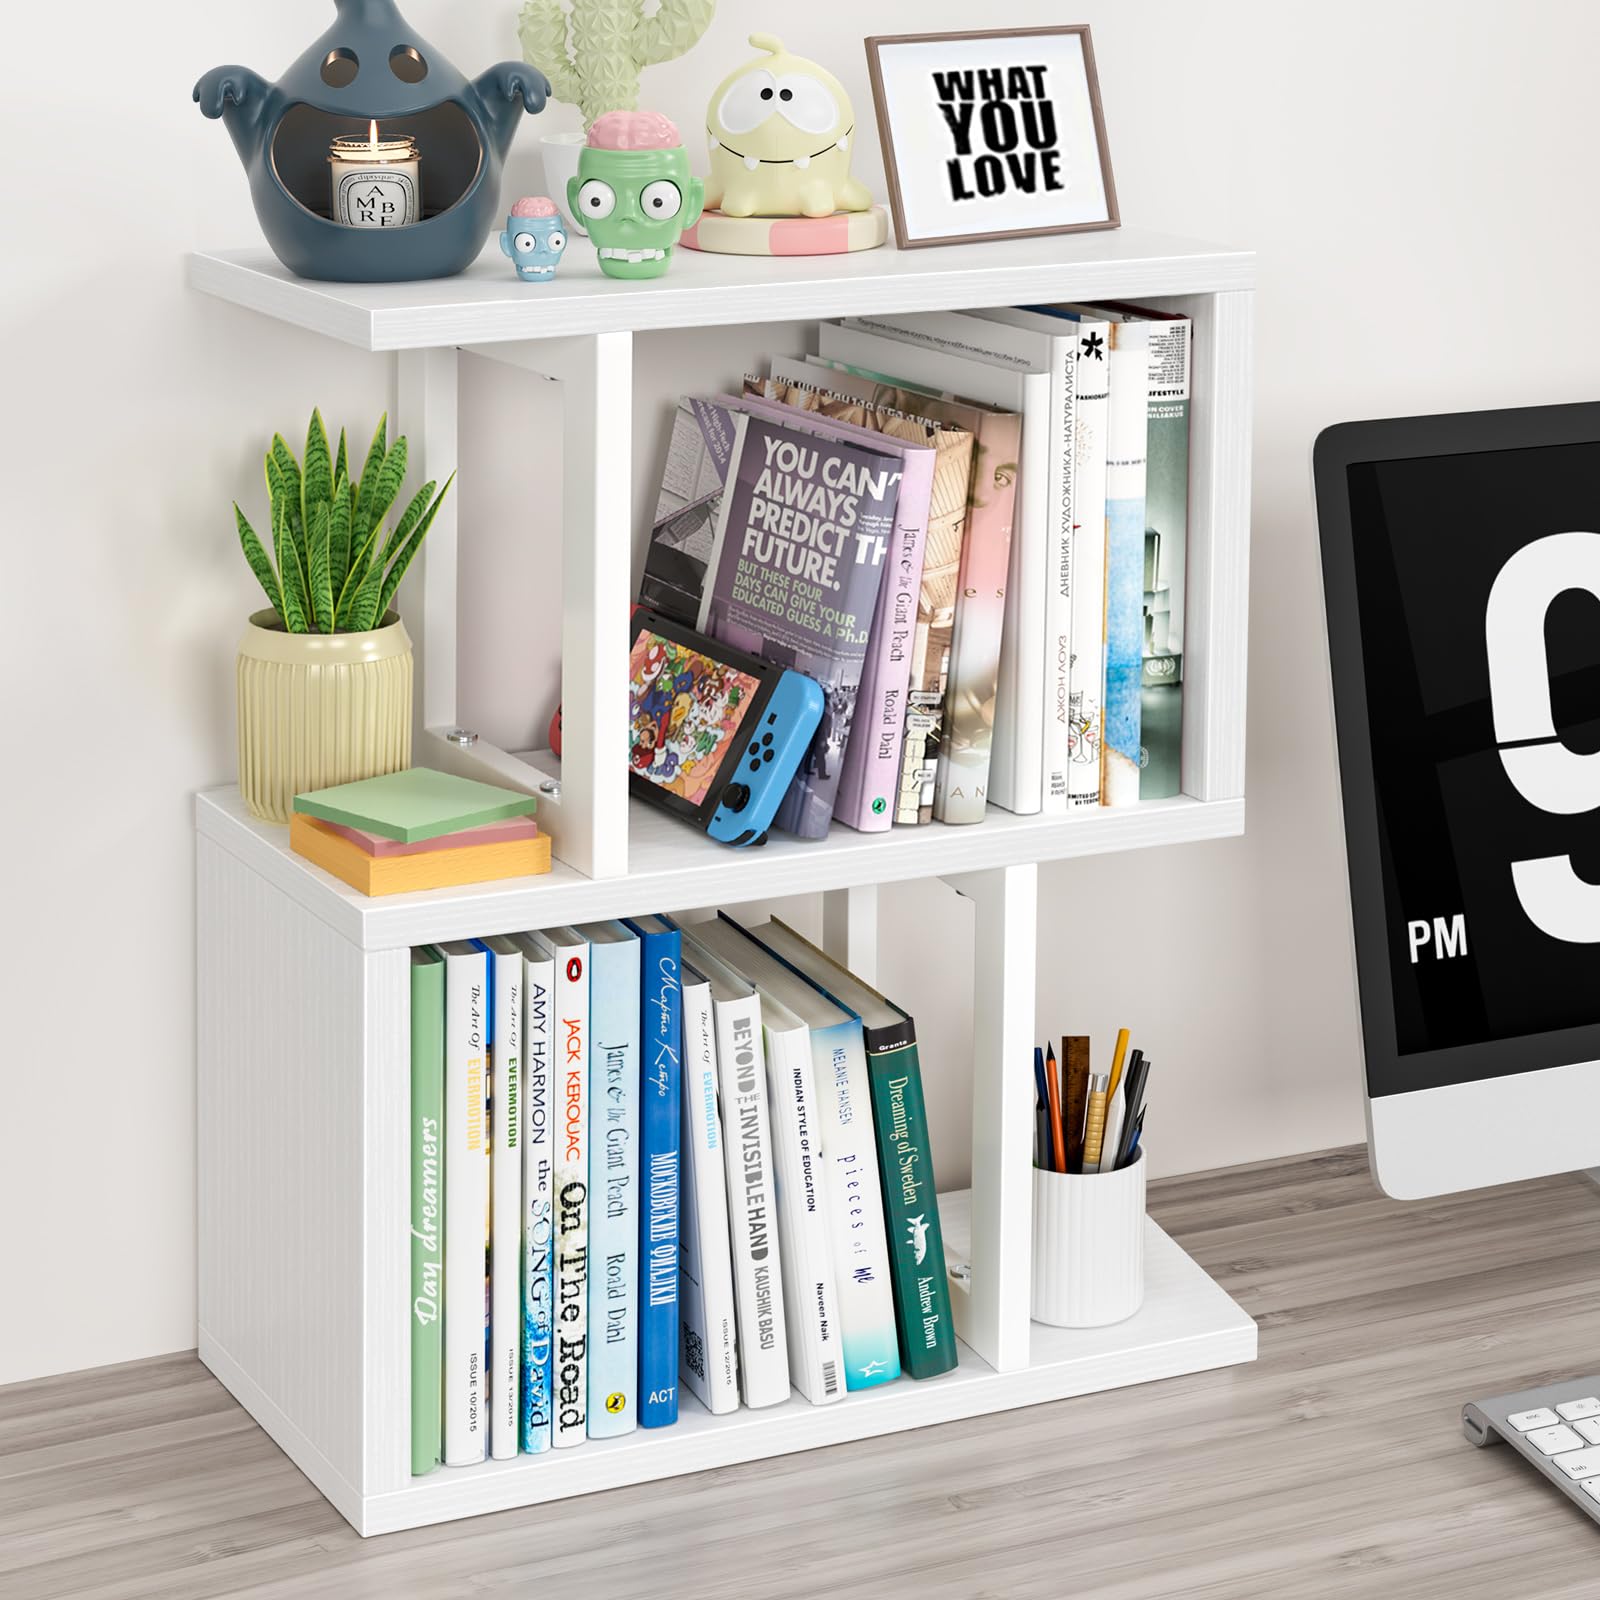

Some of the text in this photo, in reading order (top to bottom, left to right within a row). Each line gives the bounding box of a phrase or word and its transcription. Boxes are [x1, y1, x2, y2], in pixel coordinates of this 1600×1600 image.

[932, 65, 1047, 101] WHAT
[937, 99, 1058, 155] YOU
[947, 150, 1064, 201] LOVE
[713, 441, 727, 464] 2014
[763, 435, 820, 479] YOU
[1060, 350, 1075, 597] ДНЕВНИК ХУДОЖНИКА-НАТУРАЛИСТА
[752, 469, 858, 527] ALWAYS
[747, 498, 851, 558] PREDICT
[898, 524, 921, 558] James
[736, 559, 823, 601] BUT THESE FOUR
[741, 526, 840, 592] FUTURE.
[731, 588, 785, 617] EDUCATED
[786, 607, 821, 632] GUESS
[823, 623, 832, 637] A
[735, 573, 857, 629] DAYS CAN GIVE YOUR
[895, 591, 913, 624] Giant
[890, 629, 910, 663] Peach
[1057, 635, 1067, 724] ДЖОН ЛОУЗ
[882, 689, 899, 726] Roald
[878, 732, 896, 760] Dahl
[1408, 913, 1468, 964] PM
[510, 984, 518, 1002] The
[700, 1010, 708, 1027] The
[597, 1041, 629, 1085] James
[832, 1048, 849, 1088] MELANIE
[878, 1039, 908, 1051] Granta
[508, 1057, 517, 1148] EVERMOTION
[703, 1071, 718, 1150] EVERMOTION
[836, 1088, 854, 1126] HANSEN
[606, 1127, 630, 1171] Giant
[888, 1076, 923, 1206] Dreaming of Sweden
[467, 984, 481, 1433] The Art Of EVERMOTION ISSUE 10/2015
[529, 983, 551, 1429] AMY HARMON the SONG of David
[606, 1175, 631, 1219] Peach
[650, 1151, 678, 1243] МОСКОВСКИЕ
[733, 1016, 775, 1351] BEYOND THE INVISIBLE HAND KAUSHIK BASU
[793, 1067, 829, 1342] INDIAN STYLE OF EDUCATION Naveen Naik
[837, 1153, 864, 1229] pieces
[410, 1116, 443, 1327] Day dreamers
[559, 1018, 588, 1433] JACK KEROUAC On The Road
[606, 1252, 626, 1300] Roald
[649, 1243, 678, 1307] ФИАЛКИ
[605, 1307, 627, 1345] Dahl
[917, 1276, 940, 1350] Andrew Brown
